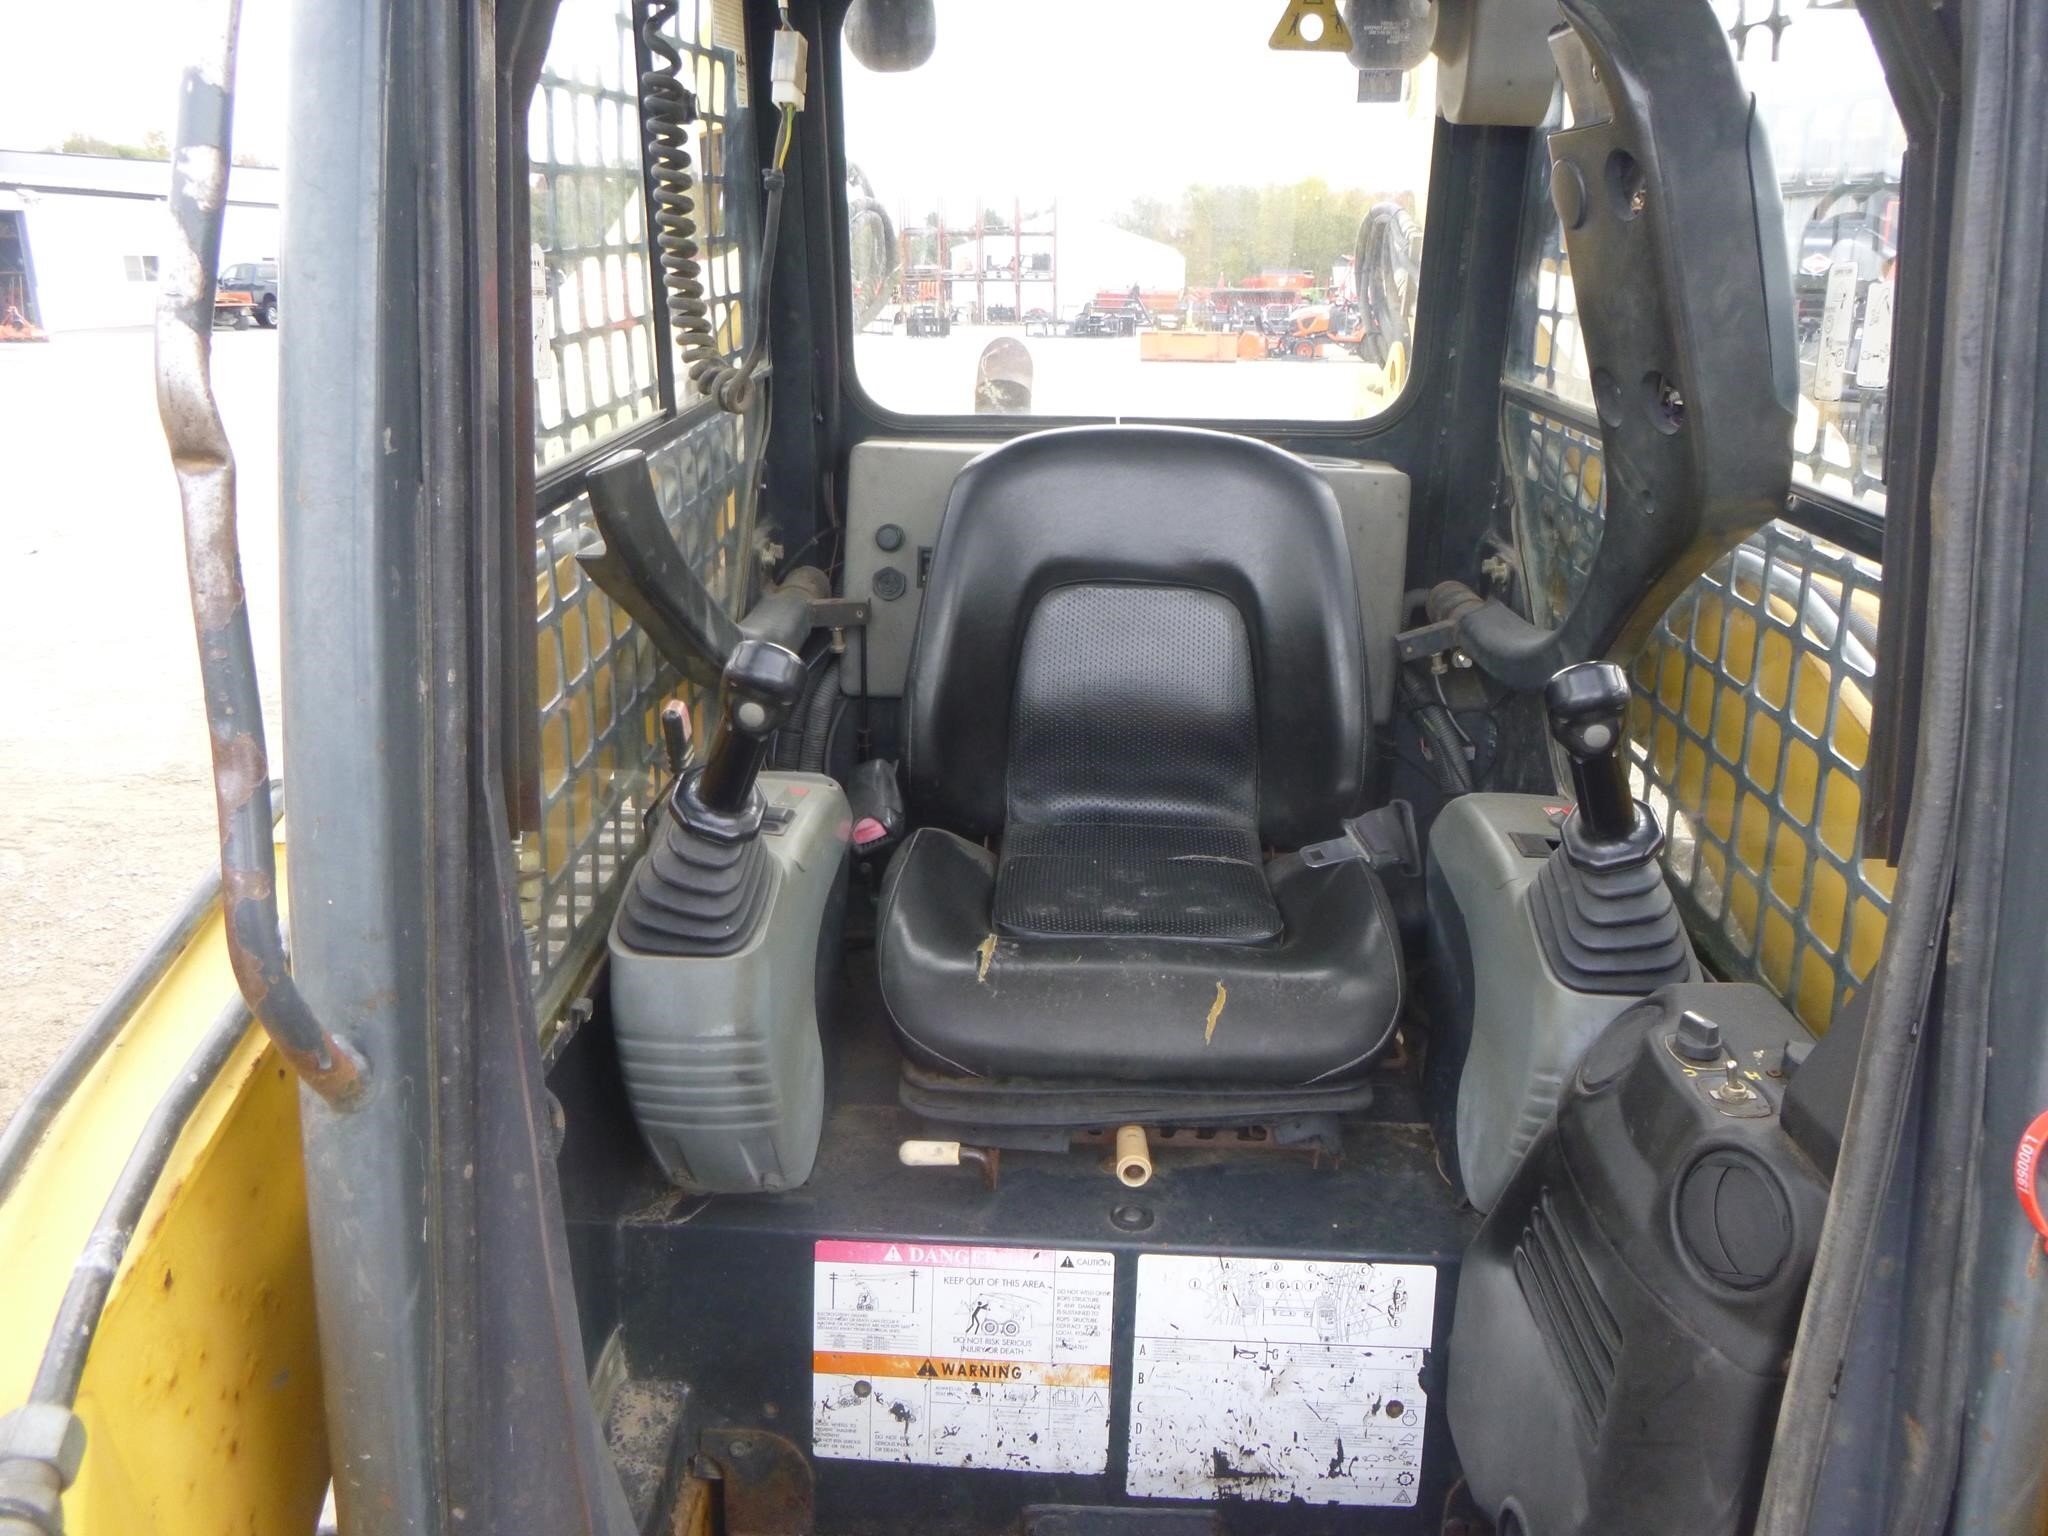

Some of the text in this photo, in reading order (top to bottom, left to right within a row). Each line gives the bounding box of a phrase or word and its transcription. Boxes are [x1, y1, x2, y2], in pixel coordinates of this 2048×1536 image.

[908, 1246, 998, 1268] DANGE
[1076, 1258, 1111, 1267] CAUTION
[943, 1276, 1046, 1289] KEEP OUT OF THIS AREA
[953, 1336, 1032, 1347] DO NOT RISK SERIOUS
[960, 1345, 986, 1354] INJURY
[1000, 1347, 1024, 1356] DEATH
[1139, 1344, 1146, 1355] A
[942, 1363, 1022, 1380] WARNING
[1138, 1372, 1144, 1384] B
[1137, 1402, 1142, 1413] C
[1136, 1423, 1142, 1434] D
